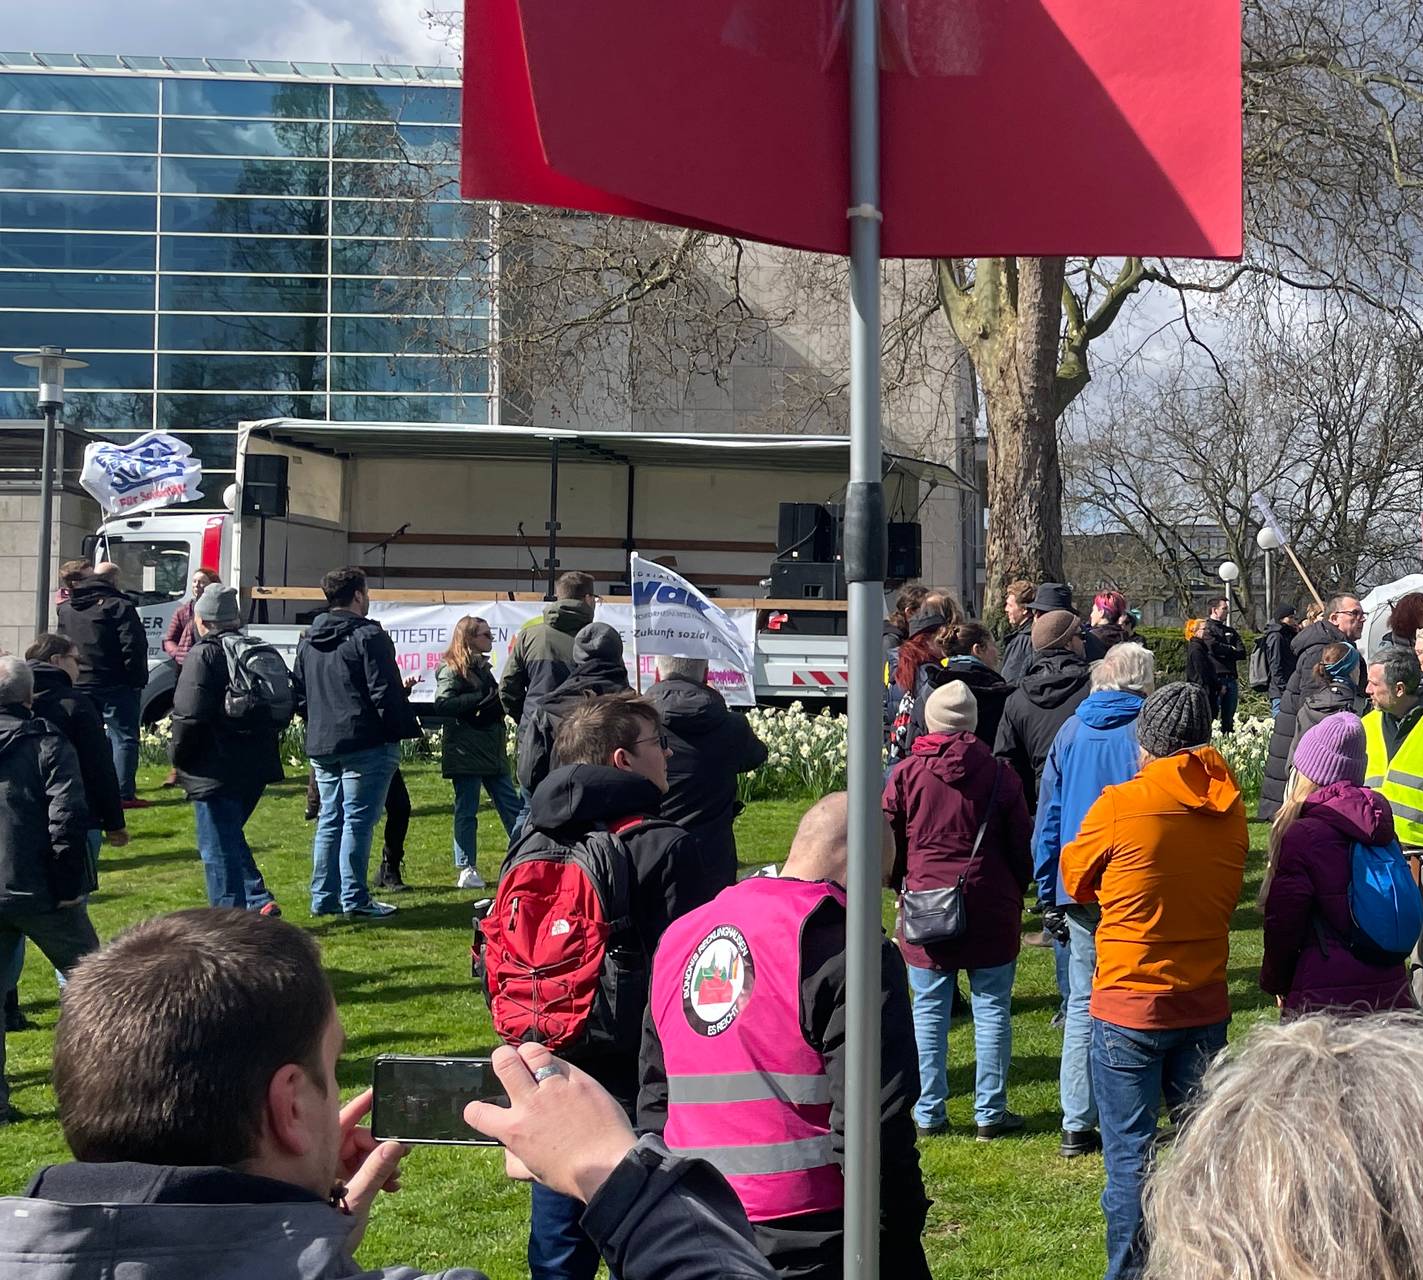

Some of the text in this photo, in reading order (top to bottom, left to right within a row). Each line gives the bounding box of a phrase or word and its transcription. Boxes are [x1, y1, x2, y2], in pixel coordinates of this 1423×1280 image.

[143, 616, 163, 629] ER
[633, 627, 674, 640] Zukunft
[678, 630, 709, 640] sozial
[697, 926, 749, 957] RECKLINGHAUSEN
[707, 1004, 740, 1036] ES REICHT
